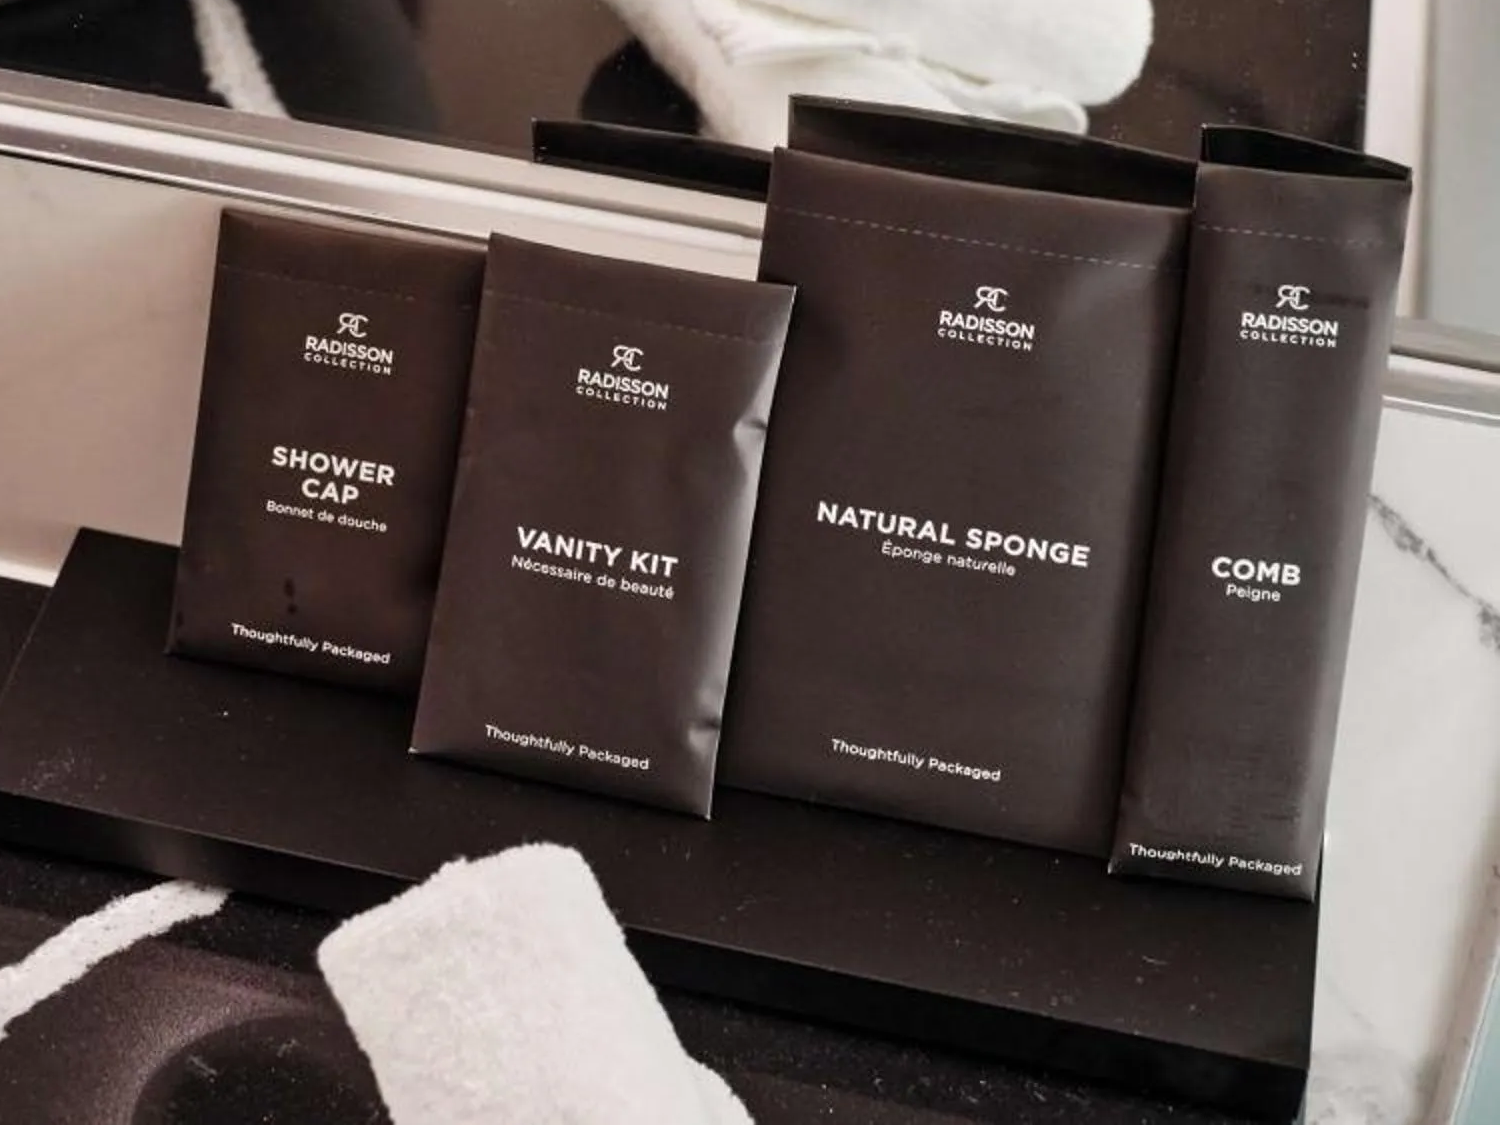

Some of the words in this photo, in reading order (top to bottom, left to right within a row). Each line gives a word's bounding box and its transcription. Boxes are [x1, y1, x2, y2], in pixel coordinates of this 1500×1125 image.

[937, 327, 1033, 351] COLLECTION
[939, 310, 1035, 341] RADISSON
[1240, 330, 1337, 348] COLLECTION
[1241, 311, 1338, 337] RADISSON
[303, 351, 392, 376] COLLECTION
[305, 335, 394, 366] RADISSON
[576, 385, 668, 411] COLLECTION
[577, 368, 669, 400] RADISSON
[271, 445, 396, 487] SHOWER
[301, 478, 360, 505] CAP
[266, 500, 314, 522] Bonnet
[317, 509, 334, 525] de
[338, 512, 388, 532] douche
[817, 500, 955, 547] NATURAL
[965, 527, 1090, 567] SPONGE
[517, 526, 623, 568] VANITY
[630, 549, 679, 577] KIT
[881, 539, 943, 567] Éponge
[946, 551, 1016, 576] naturelle
[511, 554, 592, 585] Nécessaire
[596, 571, 616, 589] de
[620, 576, 675, 599] beauté
[1211, 555, 1302, 587] COMB
[1226, 583, 1281, 605] Peigne
[231, 623, 319, 654] Thoughtfully
[322, 641, 391, 666] Packaged
[485, 724, 575, 757] Thoughtfully
[579, 744, 650, 773] Packaged
[831, 738, 925, 769] Thoughtfully
[928, 756, 1001, 783] Packaged
[1129, 842, 1224, 868] Thoughtfully
[1228, 856, 1303, 876] Packaged
